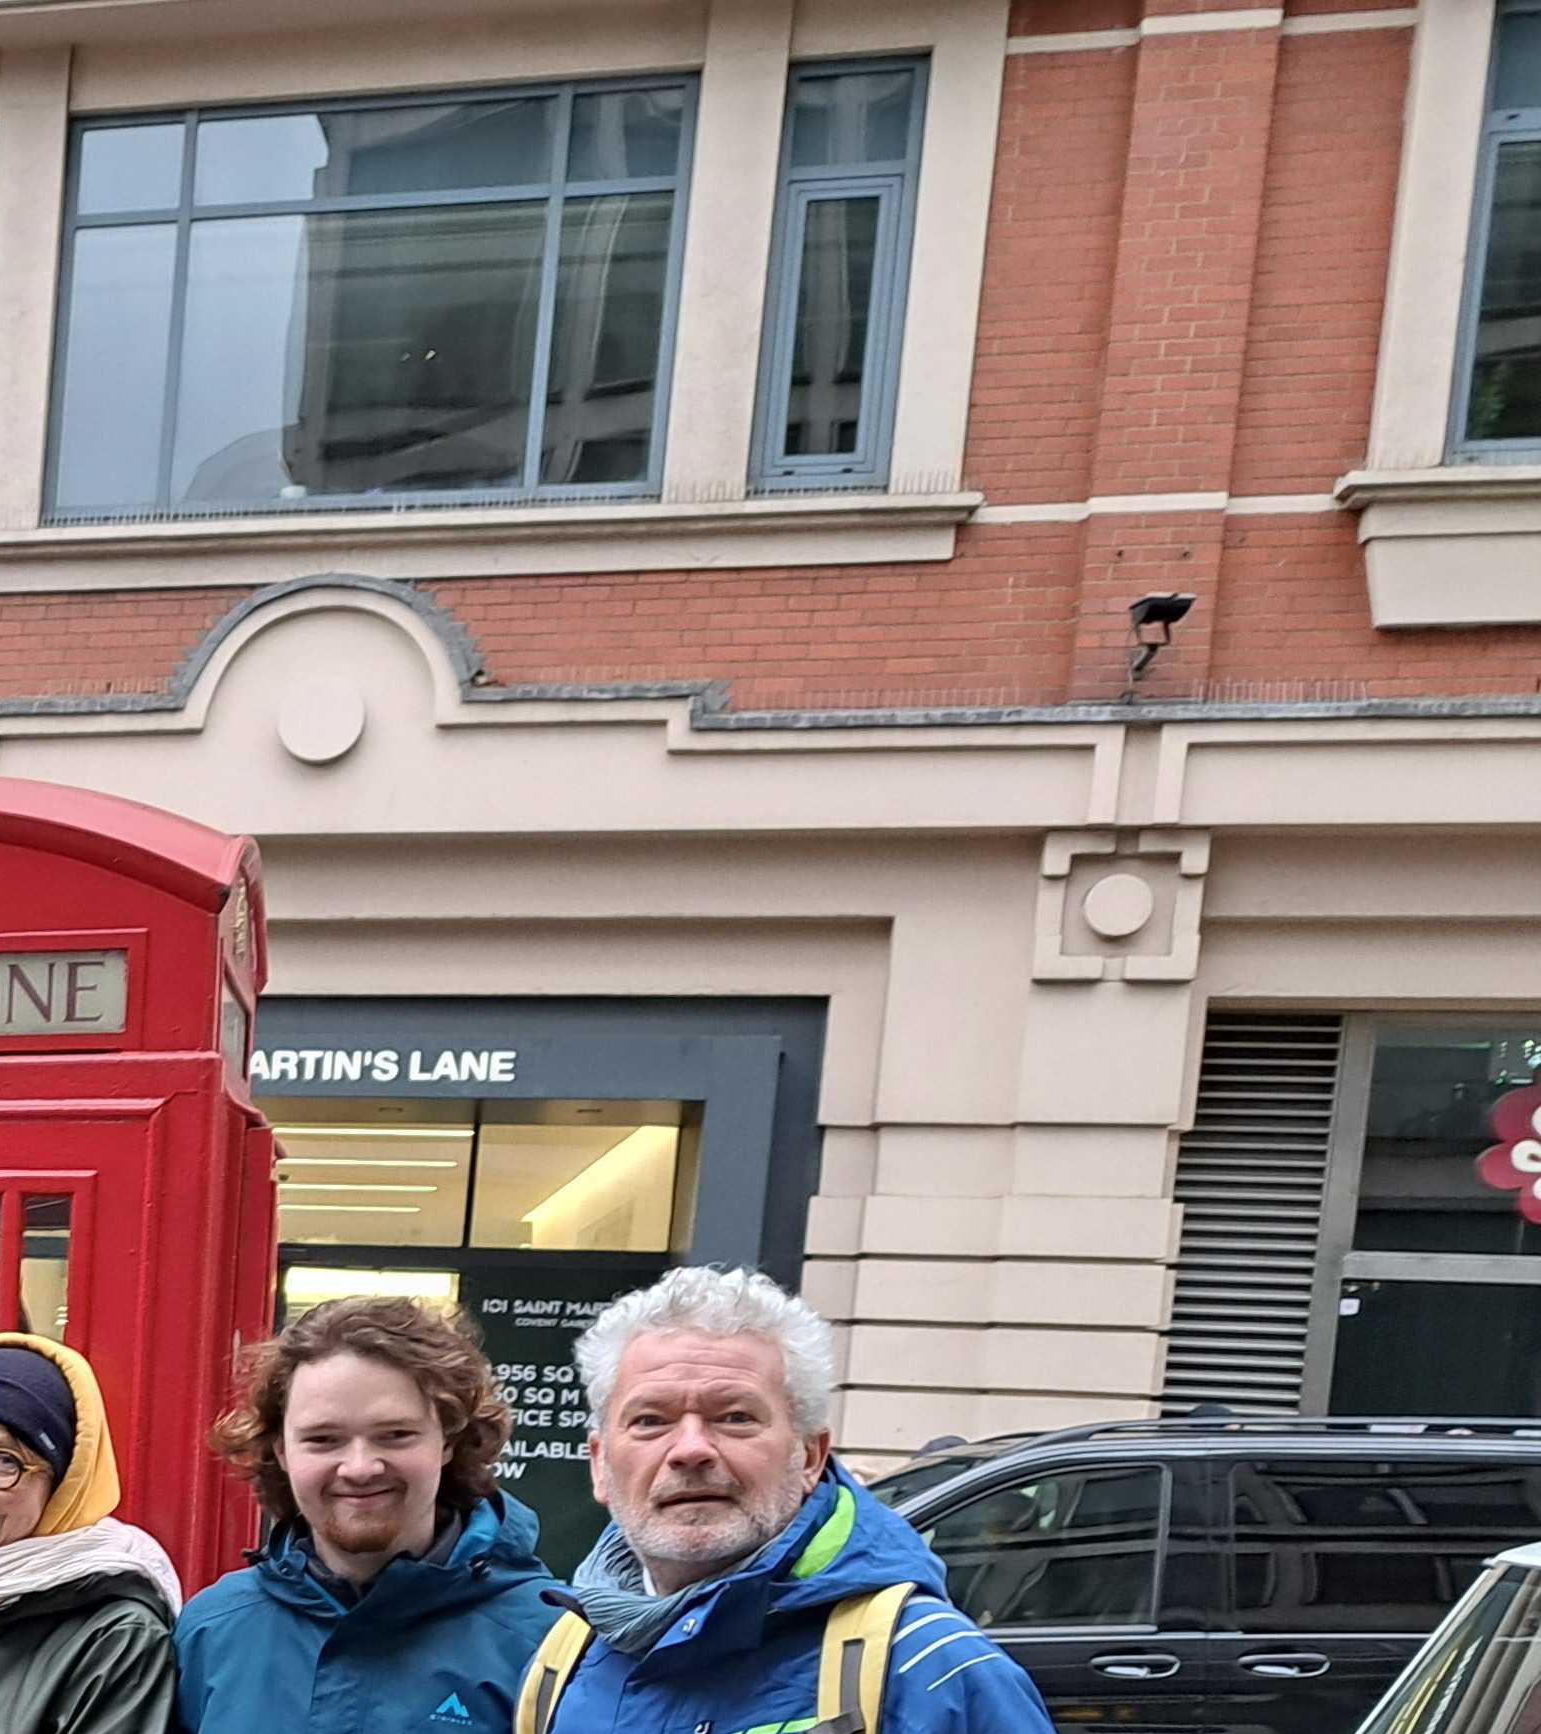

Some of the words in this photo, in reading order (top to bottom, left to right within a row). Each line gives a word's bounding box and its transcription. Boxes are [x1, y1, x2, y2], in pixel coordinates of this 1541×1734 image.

[249, 1049, 400, 1082] ARTIN'S
[408, 1050, 517, 1082] LANE
[513, 1299, 564, 1315] SAINT
[496, 1363, 538, 1383] 956
[543, 1365, 575, 1384] SQ
[524, 1388, 556, 1405] SQ
[560, 1389, 580, 1405] M
[500, 1439, 591, 1460] AILABLE
